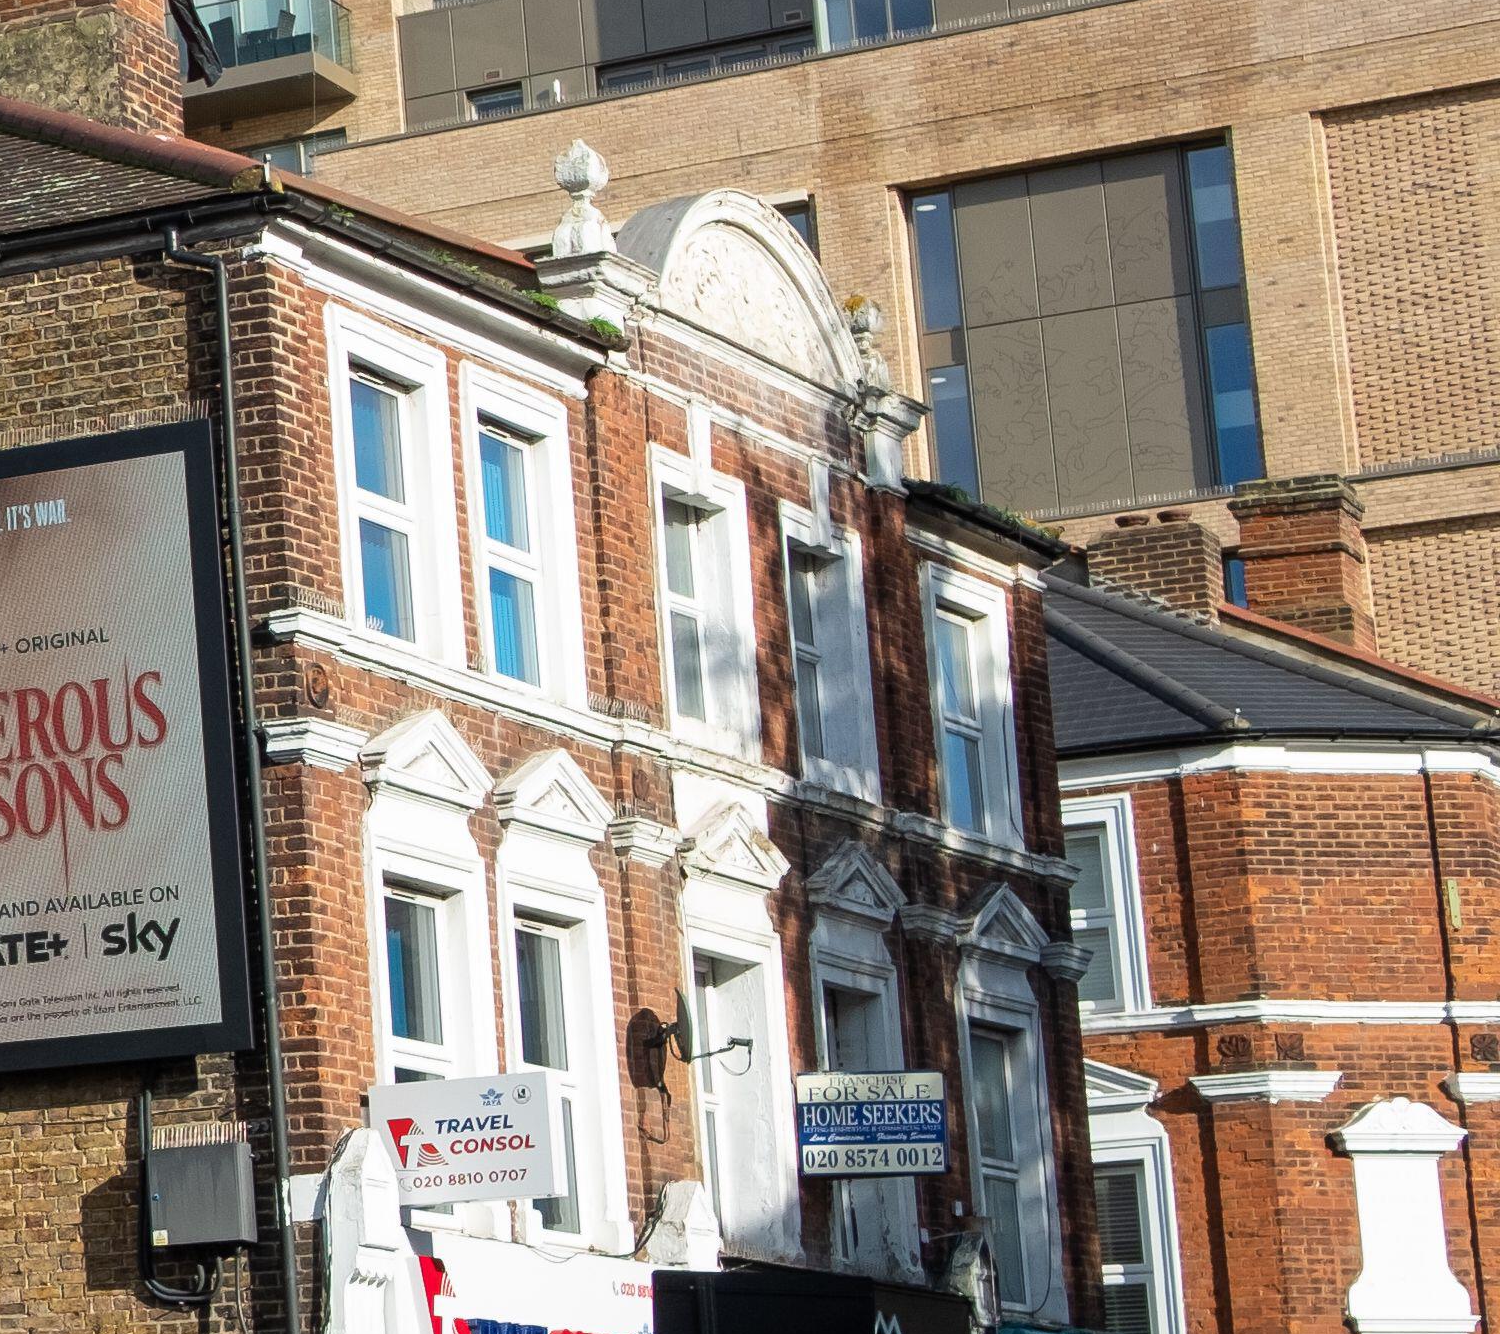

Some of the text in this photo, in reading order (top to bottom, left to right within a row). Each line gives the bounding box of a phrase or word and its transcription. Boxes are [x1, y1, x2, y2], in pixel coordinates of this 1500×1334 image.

[6, 504, 31, 531] IT'S
[15, 626, 109, 655] ORIGINAL
[44, 888, 143, 914] AVAILABLE
[149, 885, 180, 903] ON
[103, 912, 182, 962] sky
[829, 1075, 907, 1086] FRANCHISE
[808, 1084, 931, 1101] FOR SALE
[435, 1114, 513, 1134] TRAVEL
[803, 1103, 941, 1127] HOME SEEKERS
[450, 1134, 536, 1155] CONSOL
[805, 1147, 942, 1168] 020 8574 0012
[413, 1168, 527, 1188] 020 8810 0707
